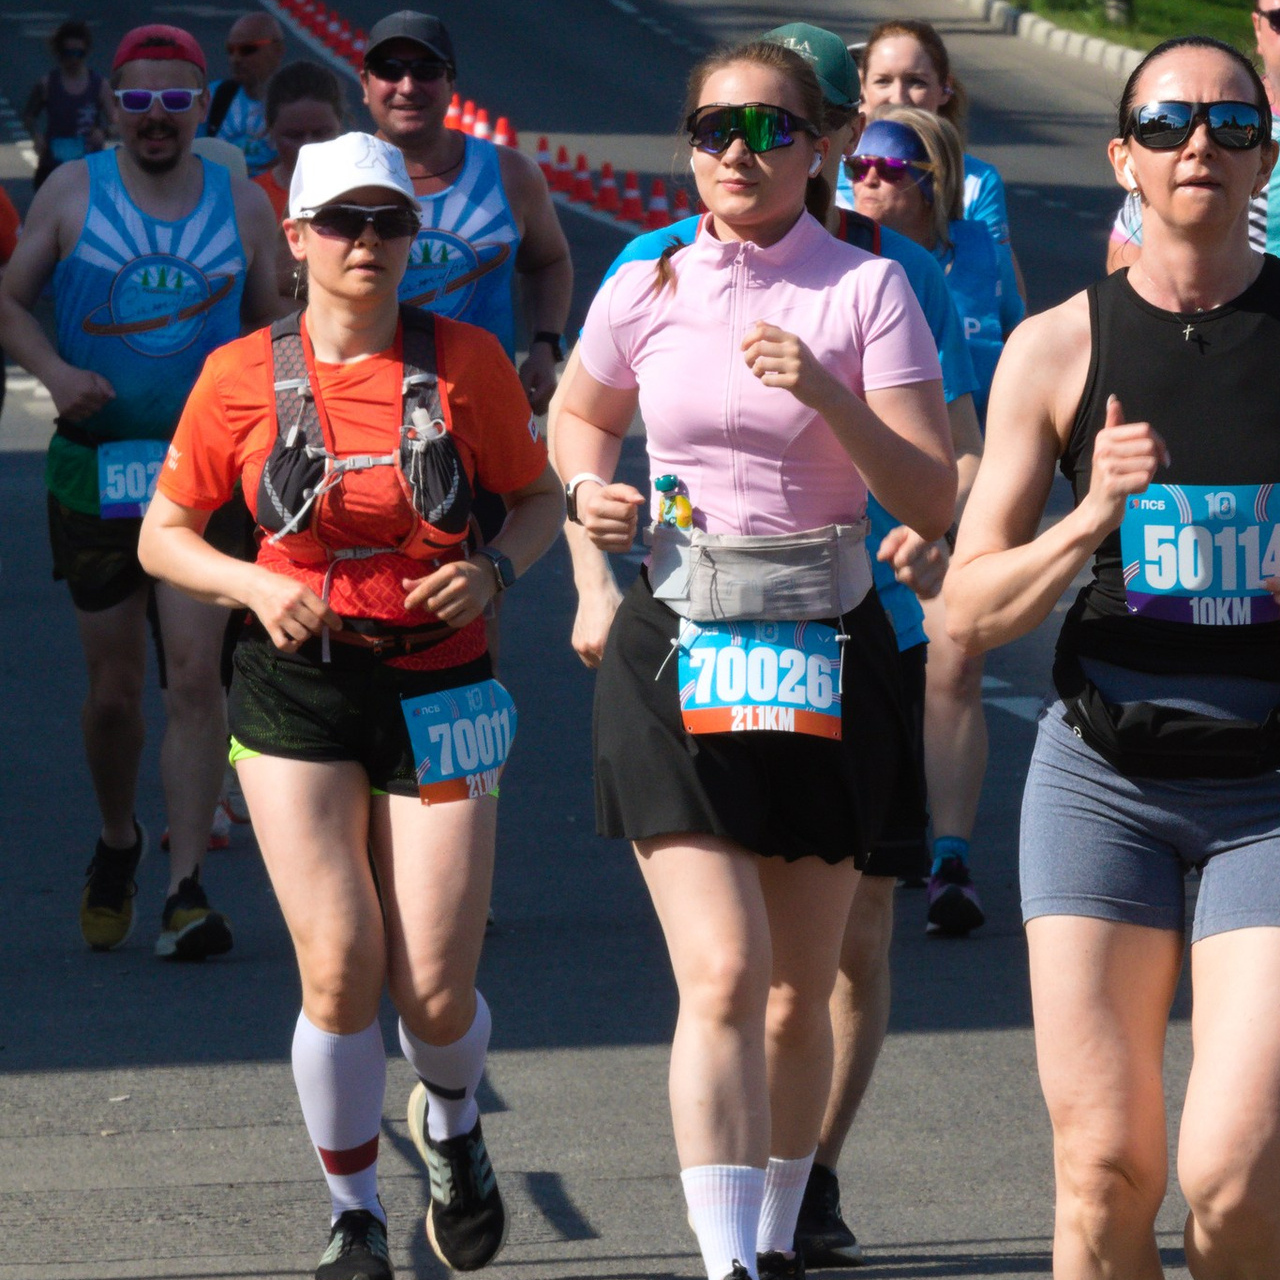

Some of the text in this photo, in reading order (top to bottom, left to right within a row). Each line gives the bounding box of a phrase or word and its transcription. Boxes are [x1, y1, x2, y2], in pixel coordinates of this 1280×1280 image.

[1140, 499, 1166, 511] ПСБ
[1189, 596, 1252, 626] 10KM
[689, 645, 833, 709] 70026
[421, 705, 441, 716] ПСБ
[730, 705, 796, 732] 21.1KM
[428, 707, 511, 776] 70011
